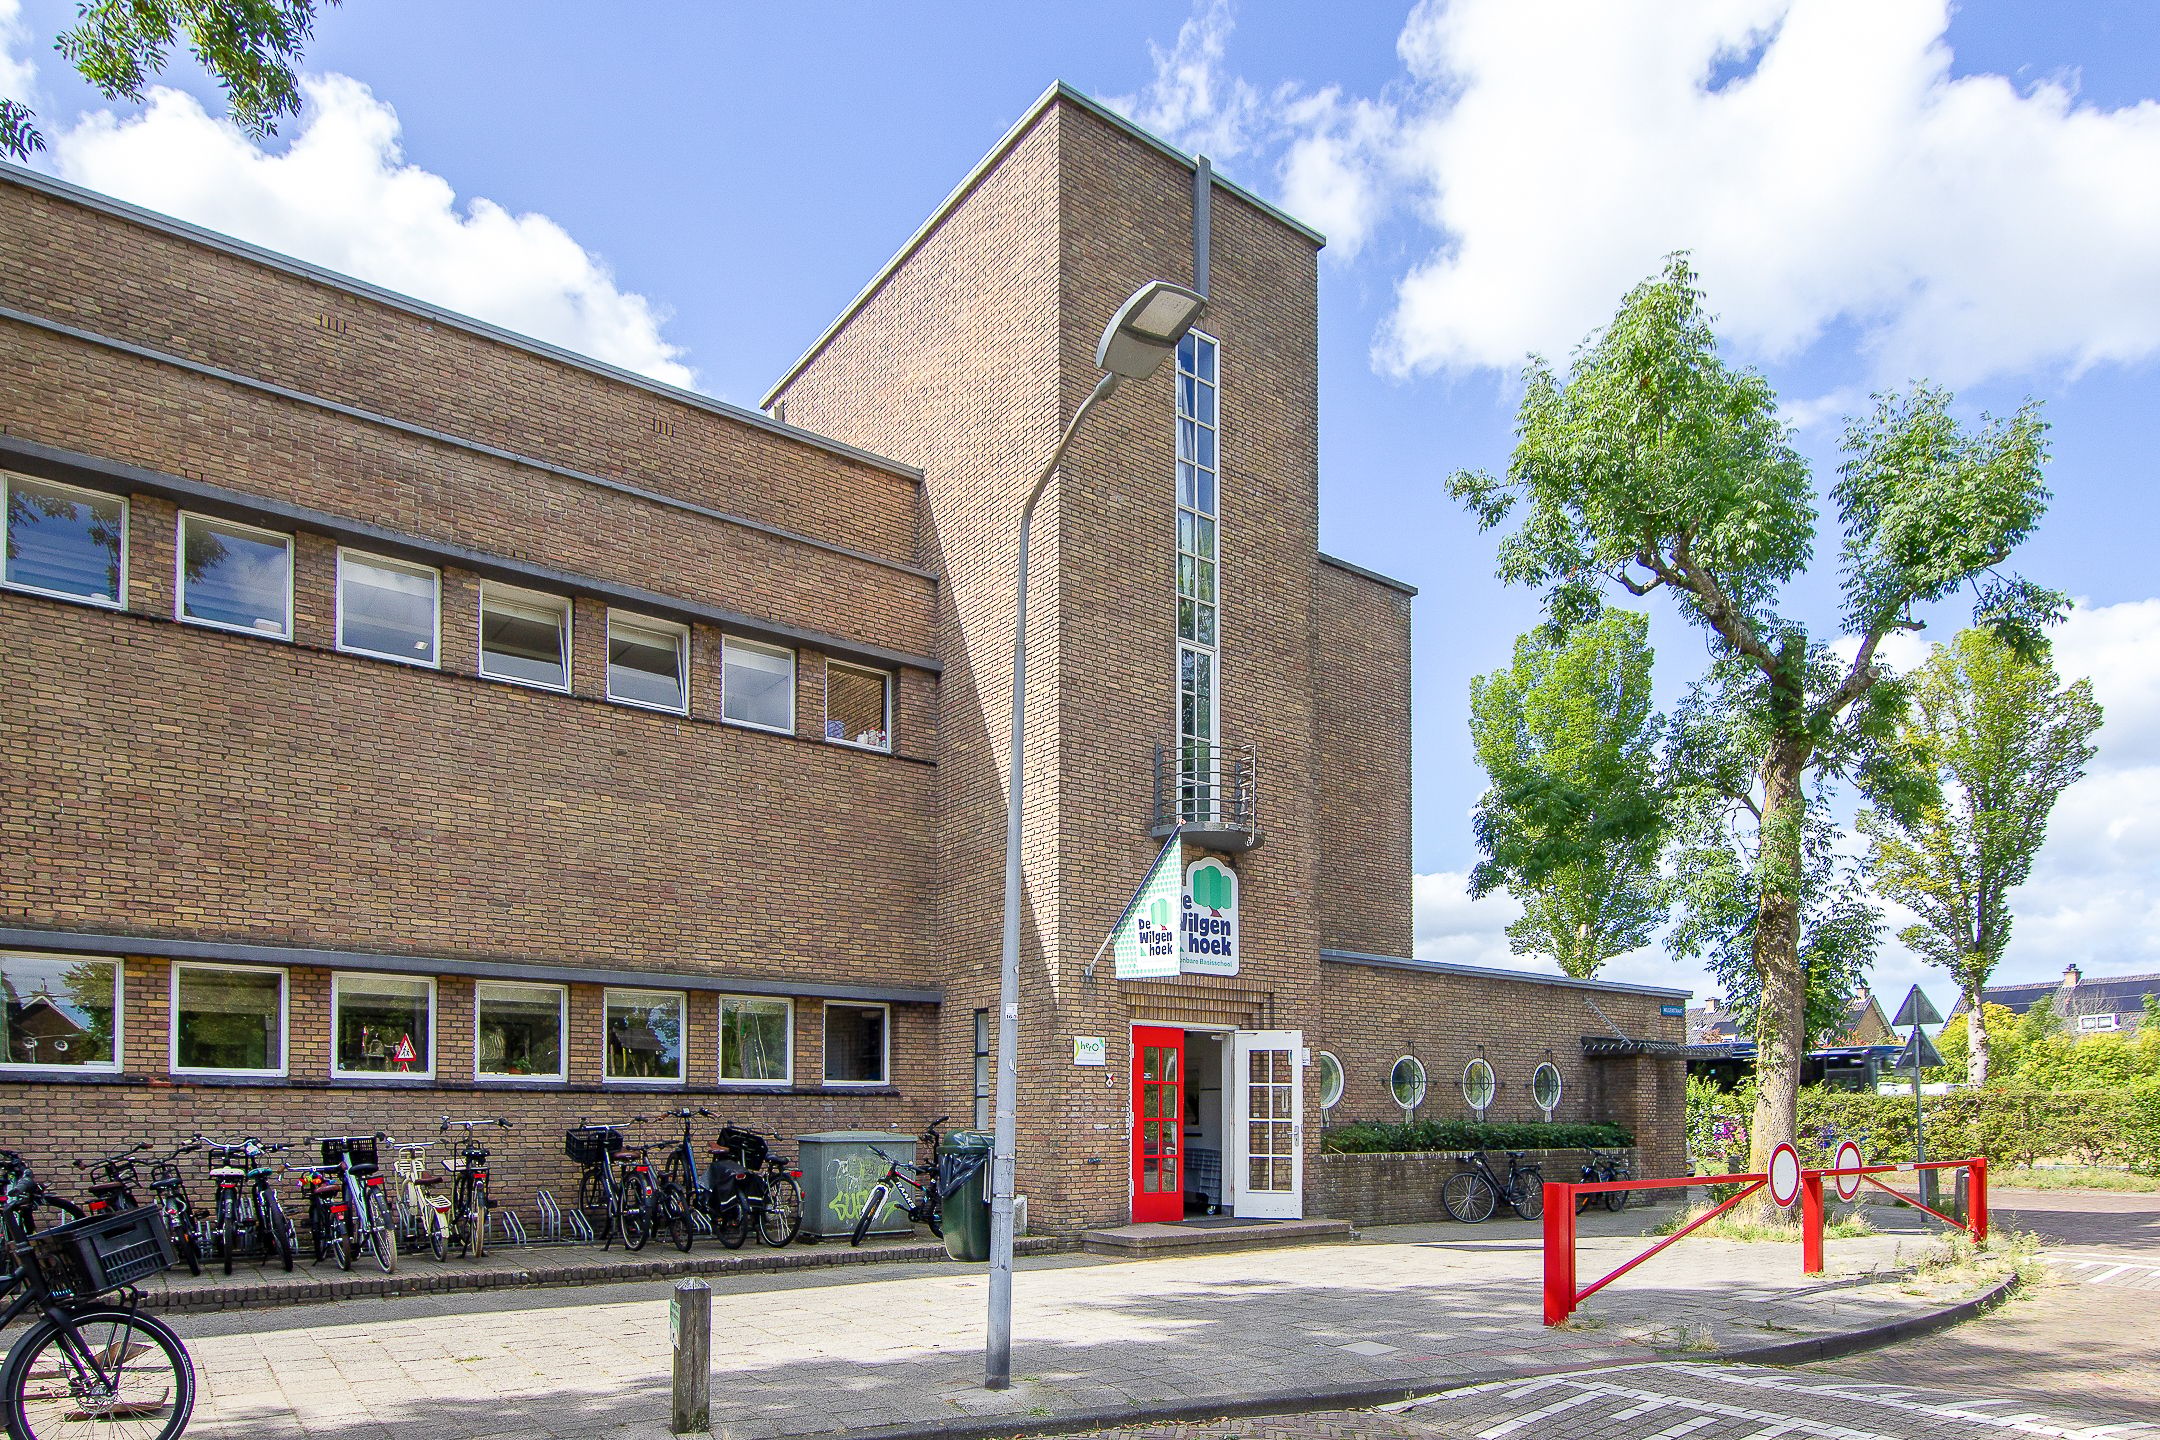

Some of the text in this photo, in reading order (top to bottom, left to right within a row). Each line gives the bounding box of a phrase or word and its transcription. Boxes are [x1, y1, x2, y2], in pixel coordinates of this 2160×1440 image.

[1138, 918, 1151, 930] De
[1139, 930, 1172, 944] Wilgen
[1149, 942, 1172, 956] hoek
[1189, 933, 1231, 956] hoek
[1199, 958, 1232, 967] Basisschool
